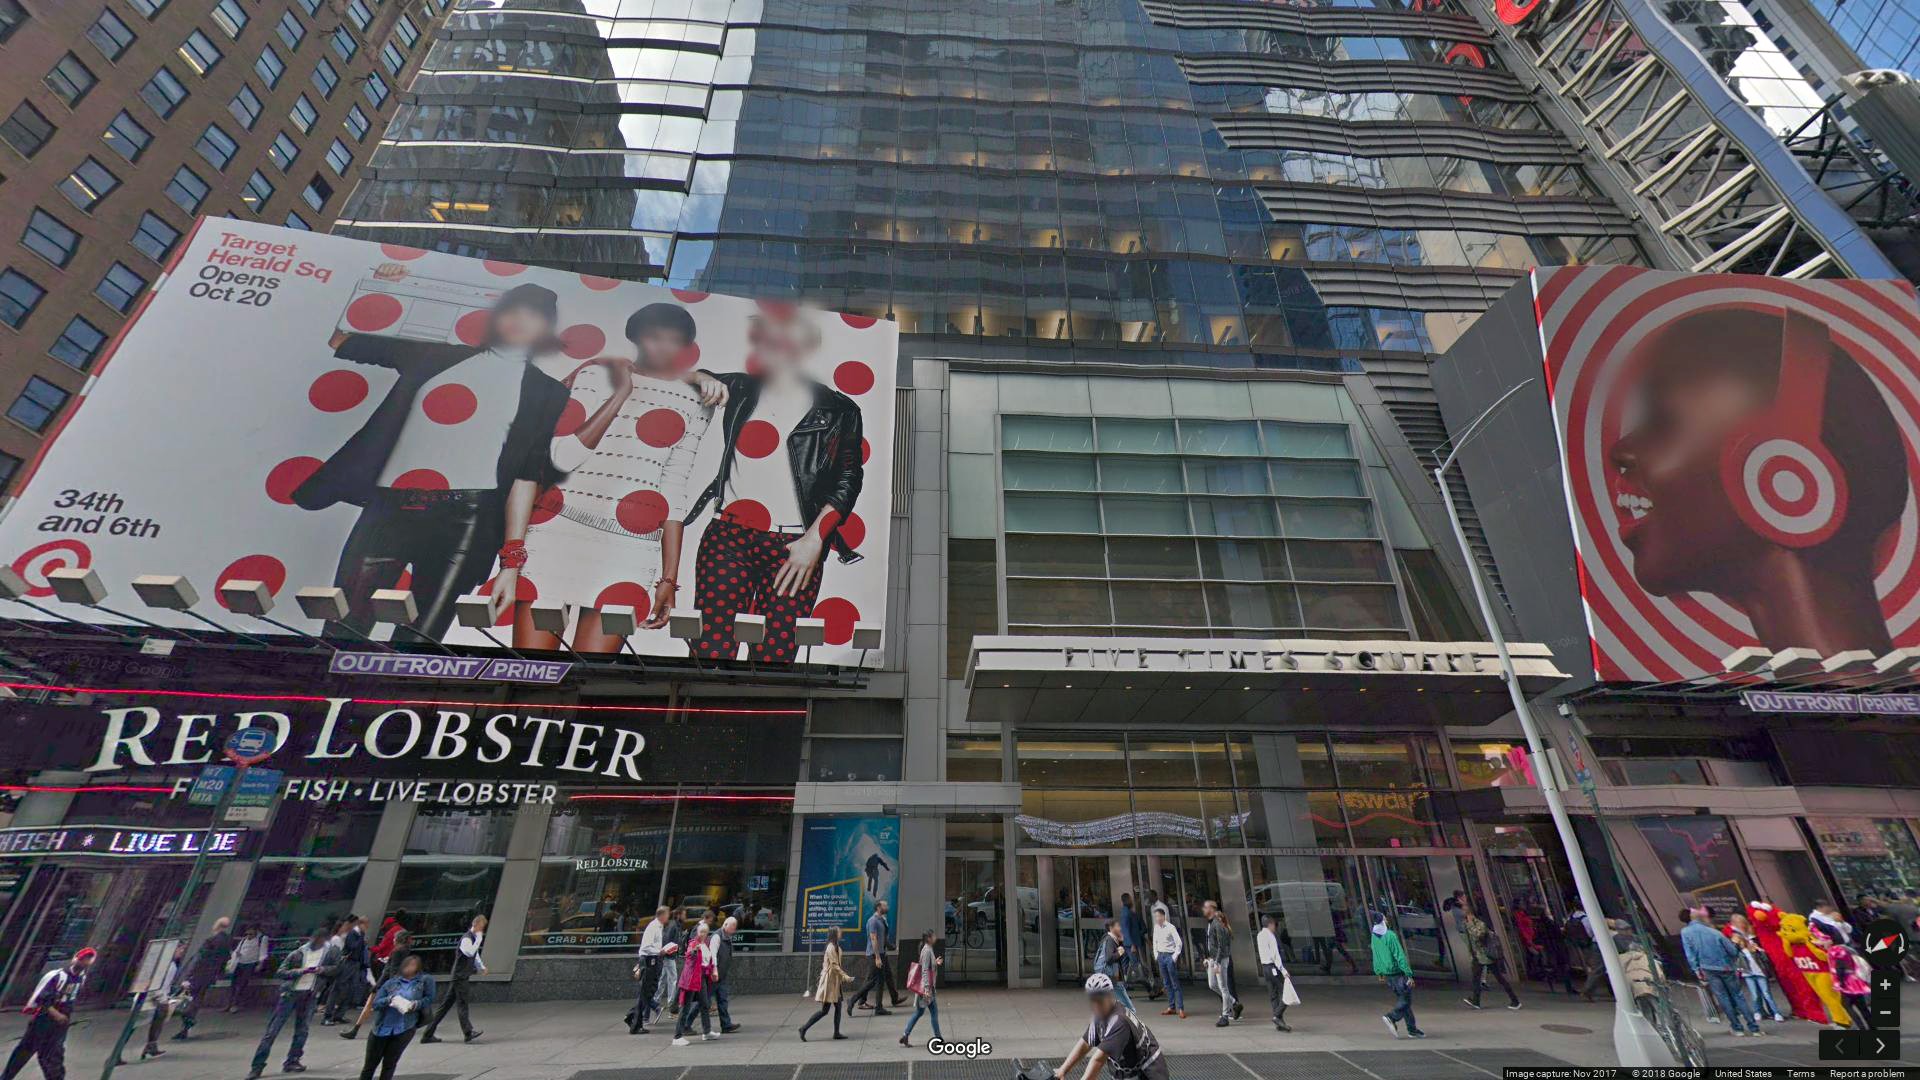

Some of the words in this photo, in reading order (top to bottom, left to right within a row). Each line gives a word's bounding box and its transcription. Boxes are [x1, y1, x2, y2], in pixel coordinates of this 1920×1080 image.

[220, 233, 298, 257] Target
[199, 265, 280, 290] Opens
[207, 249, 290, 274] Herald
[295, 261, 333, 284] Sq
[189, 283, 234, 304] Oct
[236, 289, 272, 307] 20
[53, 489, 125, 514] 34th
[37, 513, 103, 534] and
[108, 517, 161, 538] 6th
[337, 655, 481, 677] OUTFRONT
[492, 663, 561, 680] PRIME
[1065, 648, 1149, 668] FIVE
[1178, 649, 1299, 670] TIMES
[1324, 650, 1485, 672] SQUARE
[1753, 694, 1853, 711] OUTFRONT
[1865, 698, 1919, 711] PRIME
[84, 706, 291, 772] RED
[305, 697, 646, 781] LOBSTER
[283, 779, 350, 801] FISH
[370, 780, 430, 802] LIVE
[437, 782, 557, 805] LOBSTER
[11, 832, 67, 851] FISH
[109, 831, 176, 851] LIVE
[576, 858, 598, 871] RED
[600, 857, 649, 870] LOBSTER
[431, 937, 460, 946] SCALL
[547, 935, 577, 944] CRAB
[586, 935, 629, 944] CHOWDER
